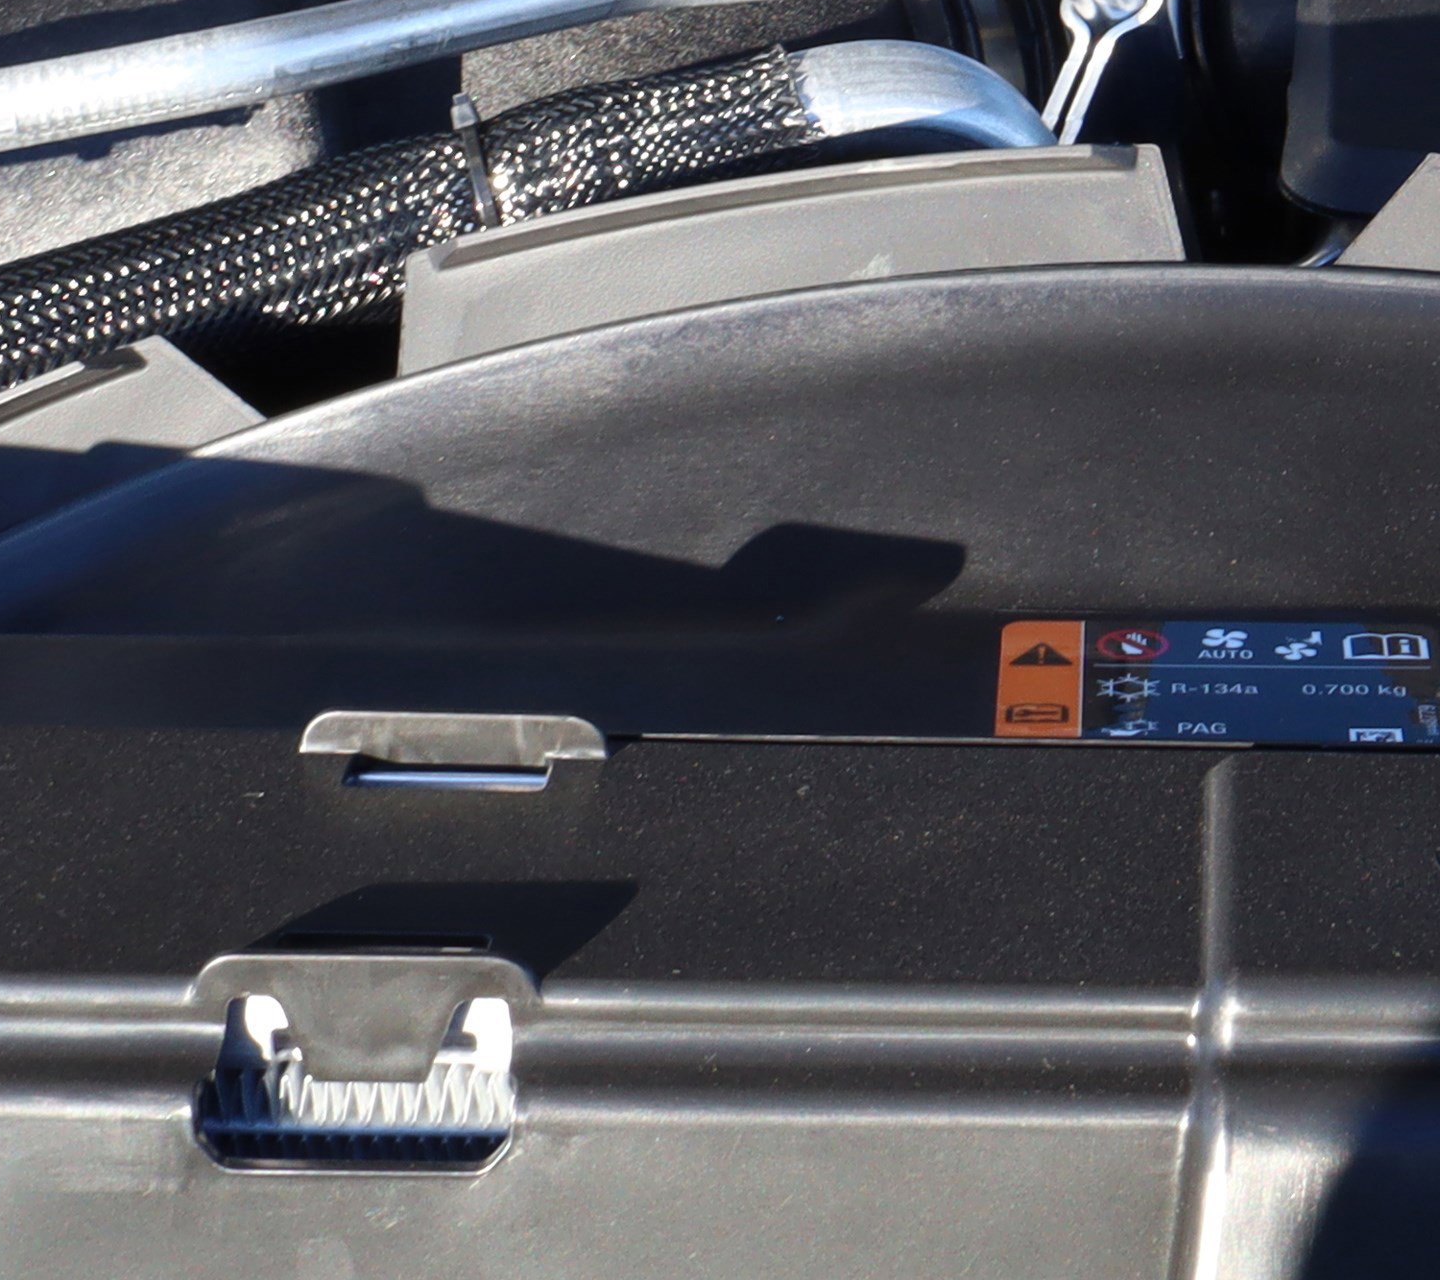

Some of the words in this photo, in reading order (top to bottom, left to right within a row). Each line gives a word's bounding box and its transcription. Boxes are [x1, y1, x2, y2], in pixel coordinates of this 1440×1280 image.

[1197, 648, 1254, 661] AUTO
[1170, 682, 1259, 696] R-134a
[1301, 683, 1370, 696] 0.700
[1377, 684, 1407, 698] kg
[1176, 721, 1228, 736] PAG
